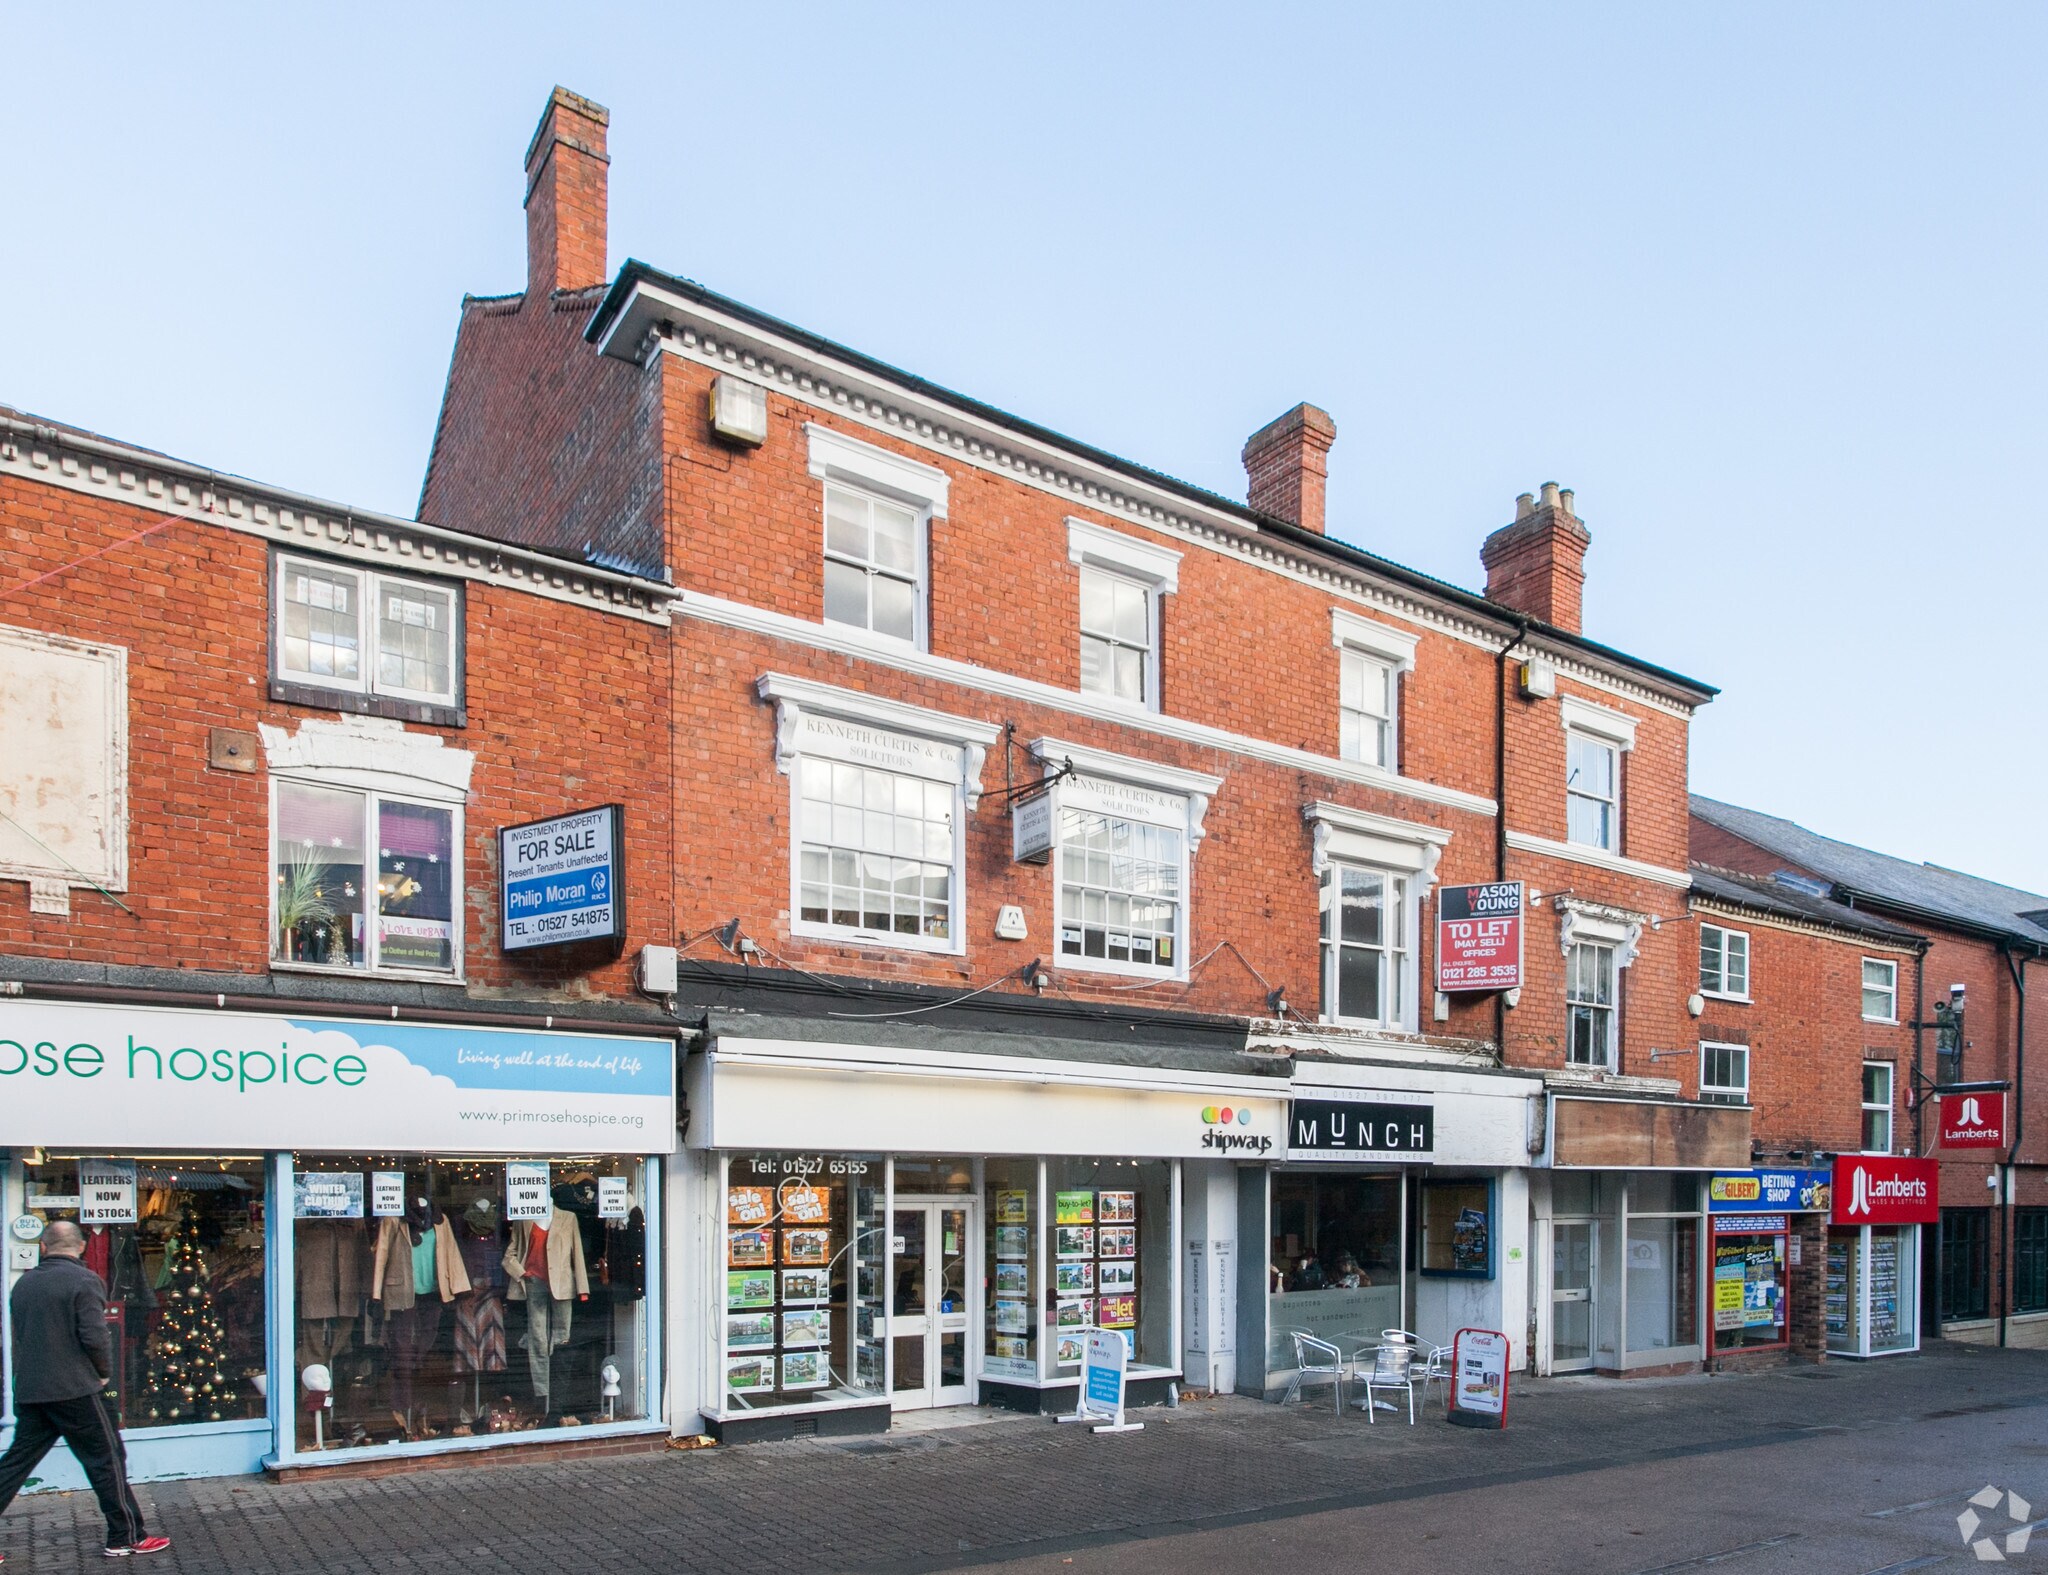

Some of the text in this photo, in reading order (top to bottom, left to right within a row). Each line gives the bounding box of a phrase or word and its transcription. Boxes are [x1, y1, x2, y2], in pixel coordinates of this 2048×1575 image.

[807, 719, 956, 762] KENNETH CURTIS & Co.
[850, 746, 912, 768] SOLICITORS
[1066, 776, 1115, 796] KENNETH
[1120, 788, 1154, 804] CURTIS
[1170, 799, 1183, 810] Co.
[1102, 800, 1150, 816] SOLICITORS
[512, 814, 602, 842] INVESTMENT PROPERTY
[519, 830, 595, 863] FOR SALE
[508, 852, 608, 879] Present Tenants Unaffected
[510, 884, 586, 909] Philip Moran
[592, 892, 606, 900] RICS
[1468, 884, 1518, 898] MASON
[1468, 896, 1518, 911] YOUNG
[509, 922, 528, 936] TEL
[538, 916, 567, 932] 01527
[572, 908, 610, 926] 541875
[1448, 920, 1512, 938] TO LET
[388, 924, 446, 937] LOVE URBAN
[526, 928, 590, 944] www.philipmoran.co.uk
[1454, 937, 1505, 948] (MAY SELL)
[1463, 948, 1496, 958] OFFICES
[1443, 965, 1516, 979] 0121 285 3535
[1443, 977, 1516, 986] www.masonyoung.co.uk
[128, 1035, 368, 1092] hospice
[458, 1048, 642, 1076] Living well at the end of life
[1334, 1090, 1368, 1099] 01527
[460, 1110, 644, 1128] www.primrosehospice.org
[1299, 1112, 1424, 1148] MUNCH
[1946, 1128, 1998, 1138] Lamberts
[1202, 1128, 1272, 1156] shipways
[1299, 1150, 1424, 1160] QUALITY SANDWICHES
[749, 1159, 868, 1174] Tel: 01527 65155
[82, 1175, 132, 1185] LEATHERS
[509, 1177, 546, 1186] LEATHERS
[1762, 1175, 1796, 1188] BETTING
[1869, 1173, 1926, 1197] Lamberts
[96, 1192, 121, 1200] NOW
[310, 1184, 346, 1194] WINTER
[520, 1192, 538, 1200] NOW
[1725, 1182, 1756, 1198] GILBERT
[1767, 1189, 1791, 1202] SHOP
[304, 1196, 350, 1206] CLOTHING
[729, 1190, 762, 1206] sale
[788, 1190, 818, 1206] sale
[1058, 1200, 1092, 1210] buy-to-let?
[84, 1208, 132, 1218] IN STOCK
[520, 1206, 546, 1214] STOCK
[736, 1204, 750, 1212] now
[740, 1203, 766, 1221] on!
[798, 1203, 823, 1220] on!
[1116, 1298, 1134, 1317] let
